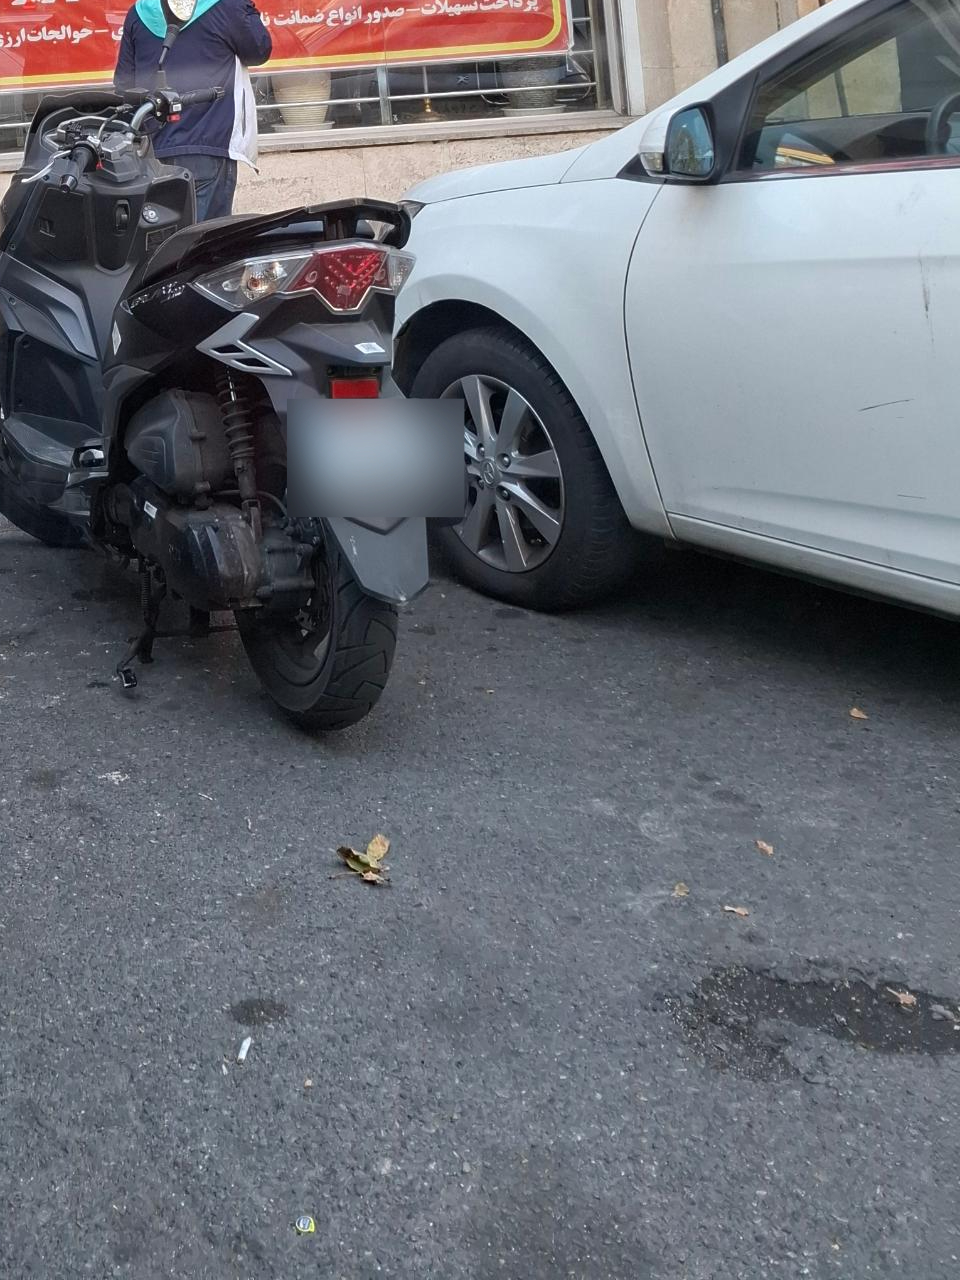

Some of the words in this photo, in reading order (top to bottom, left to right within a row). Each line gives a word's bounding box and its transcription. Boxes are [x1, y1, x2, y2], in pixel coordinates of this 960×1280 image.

[273, 10, 324, 28] ضمانت
[325, 5, 362, 27] انواع
[364, 5, 405, 24] صدور
[26, 21, 94, 45] حوالجات
